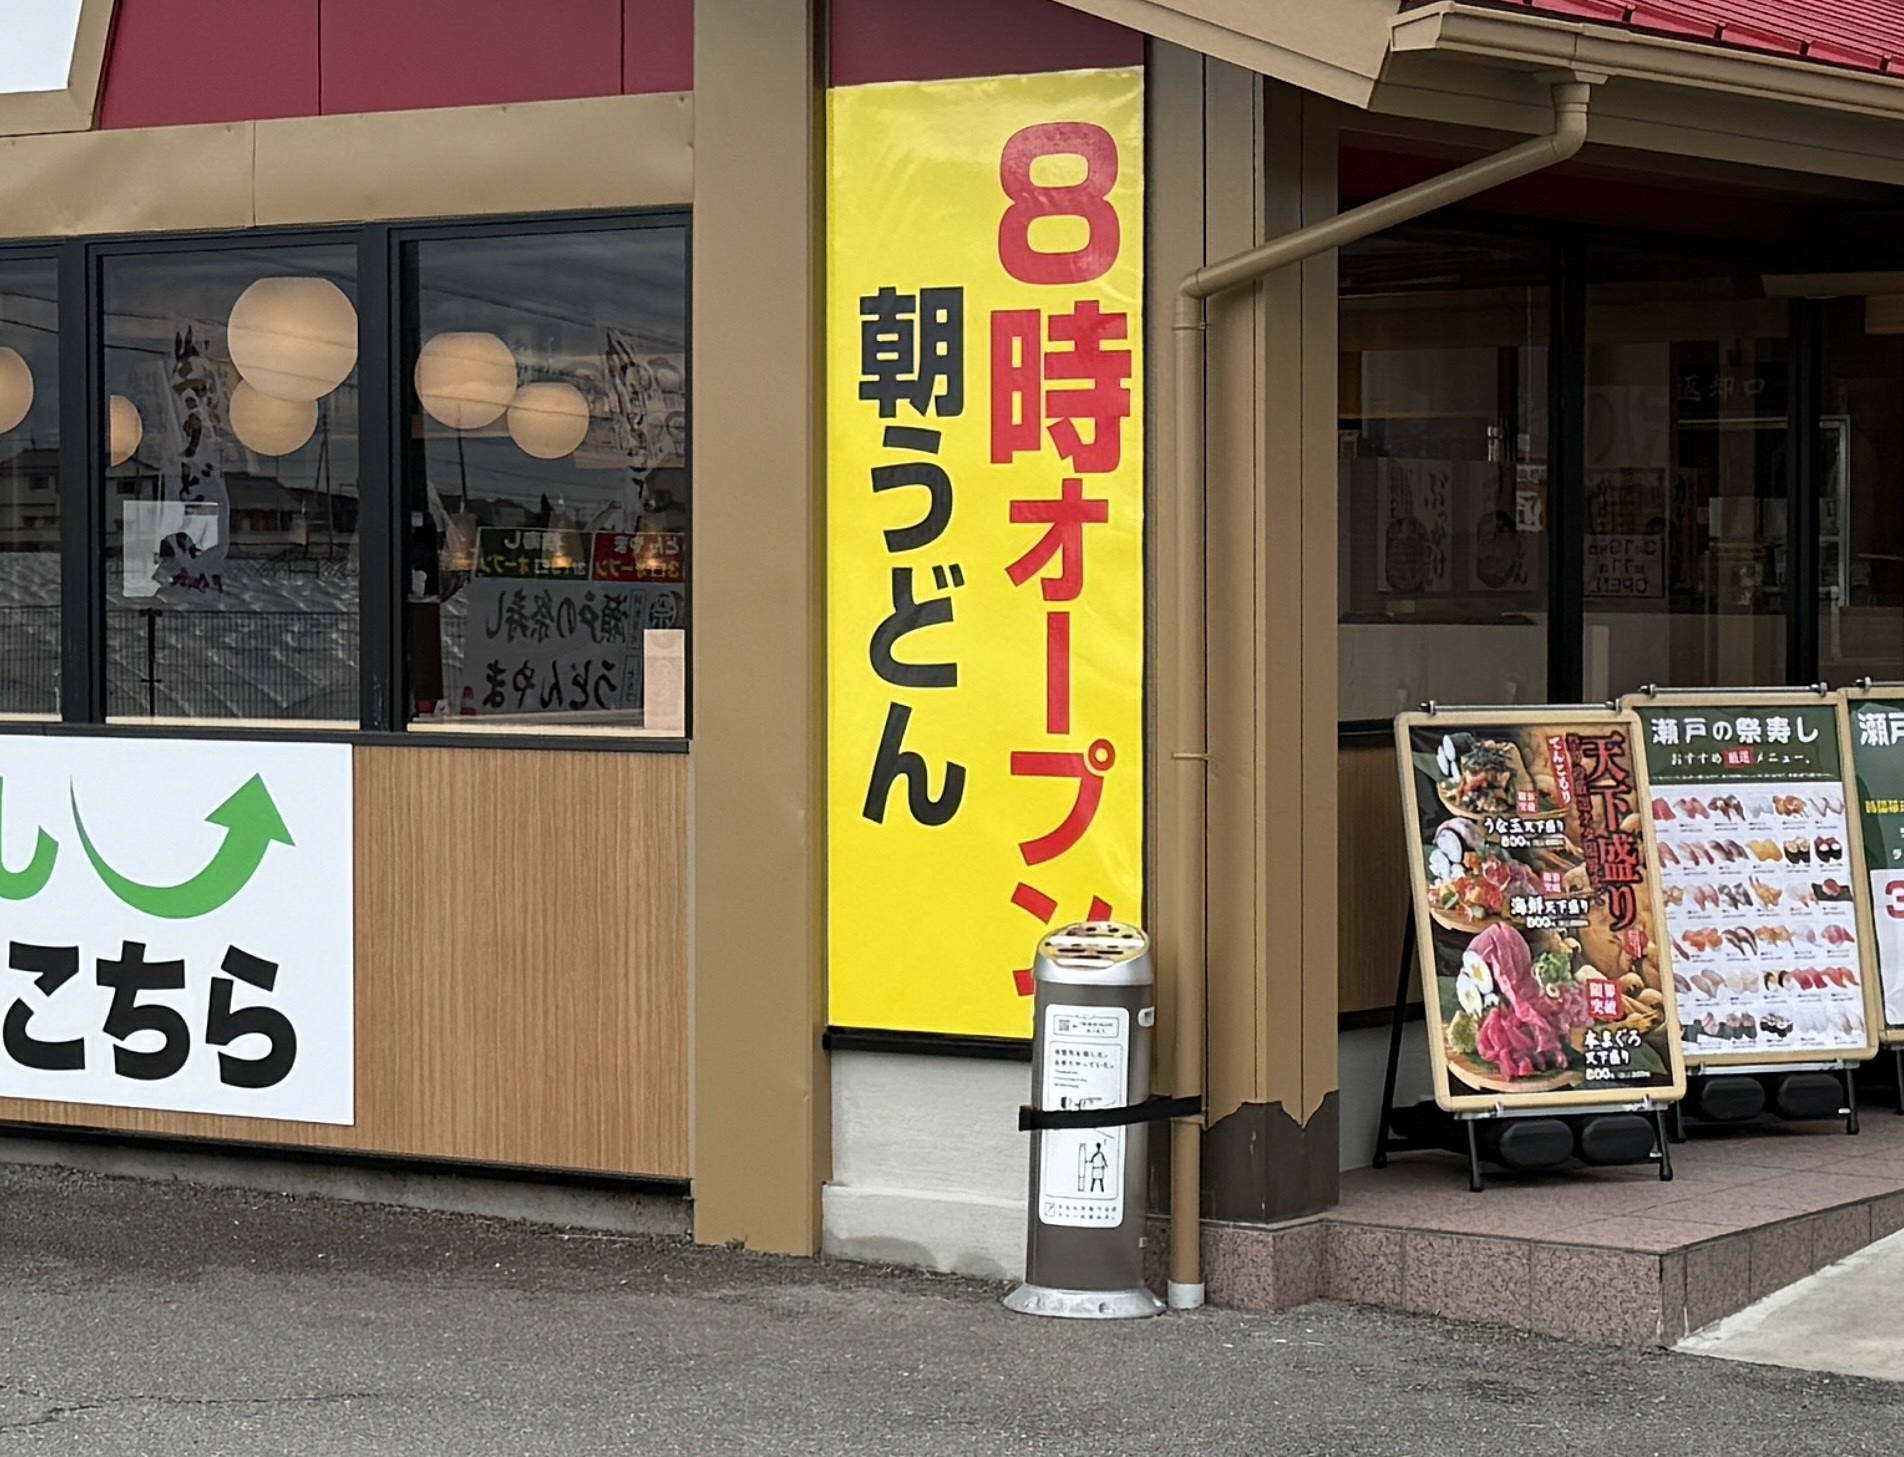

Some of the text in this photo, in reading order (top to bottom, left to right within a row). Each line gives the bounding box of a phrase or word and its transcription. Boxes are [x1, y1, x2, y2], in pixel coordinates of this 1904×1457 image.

[858, 285, 967, 829] 朝うどん
[1651, 716, 1819, 745] 瀬戸の祭寿し
[1583, 732, 1640, 931] 天下盛り
[1585, 1028, 1643, 1049] 本まぐろ
